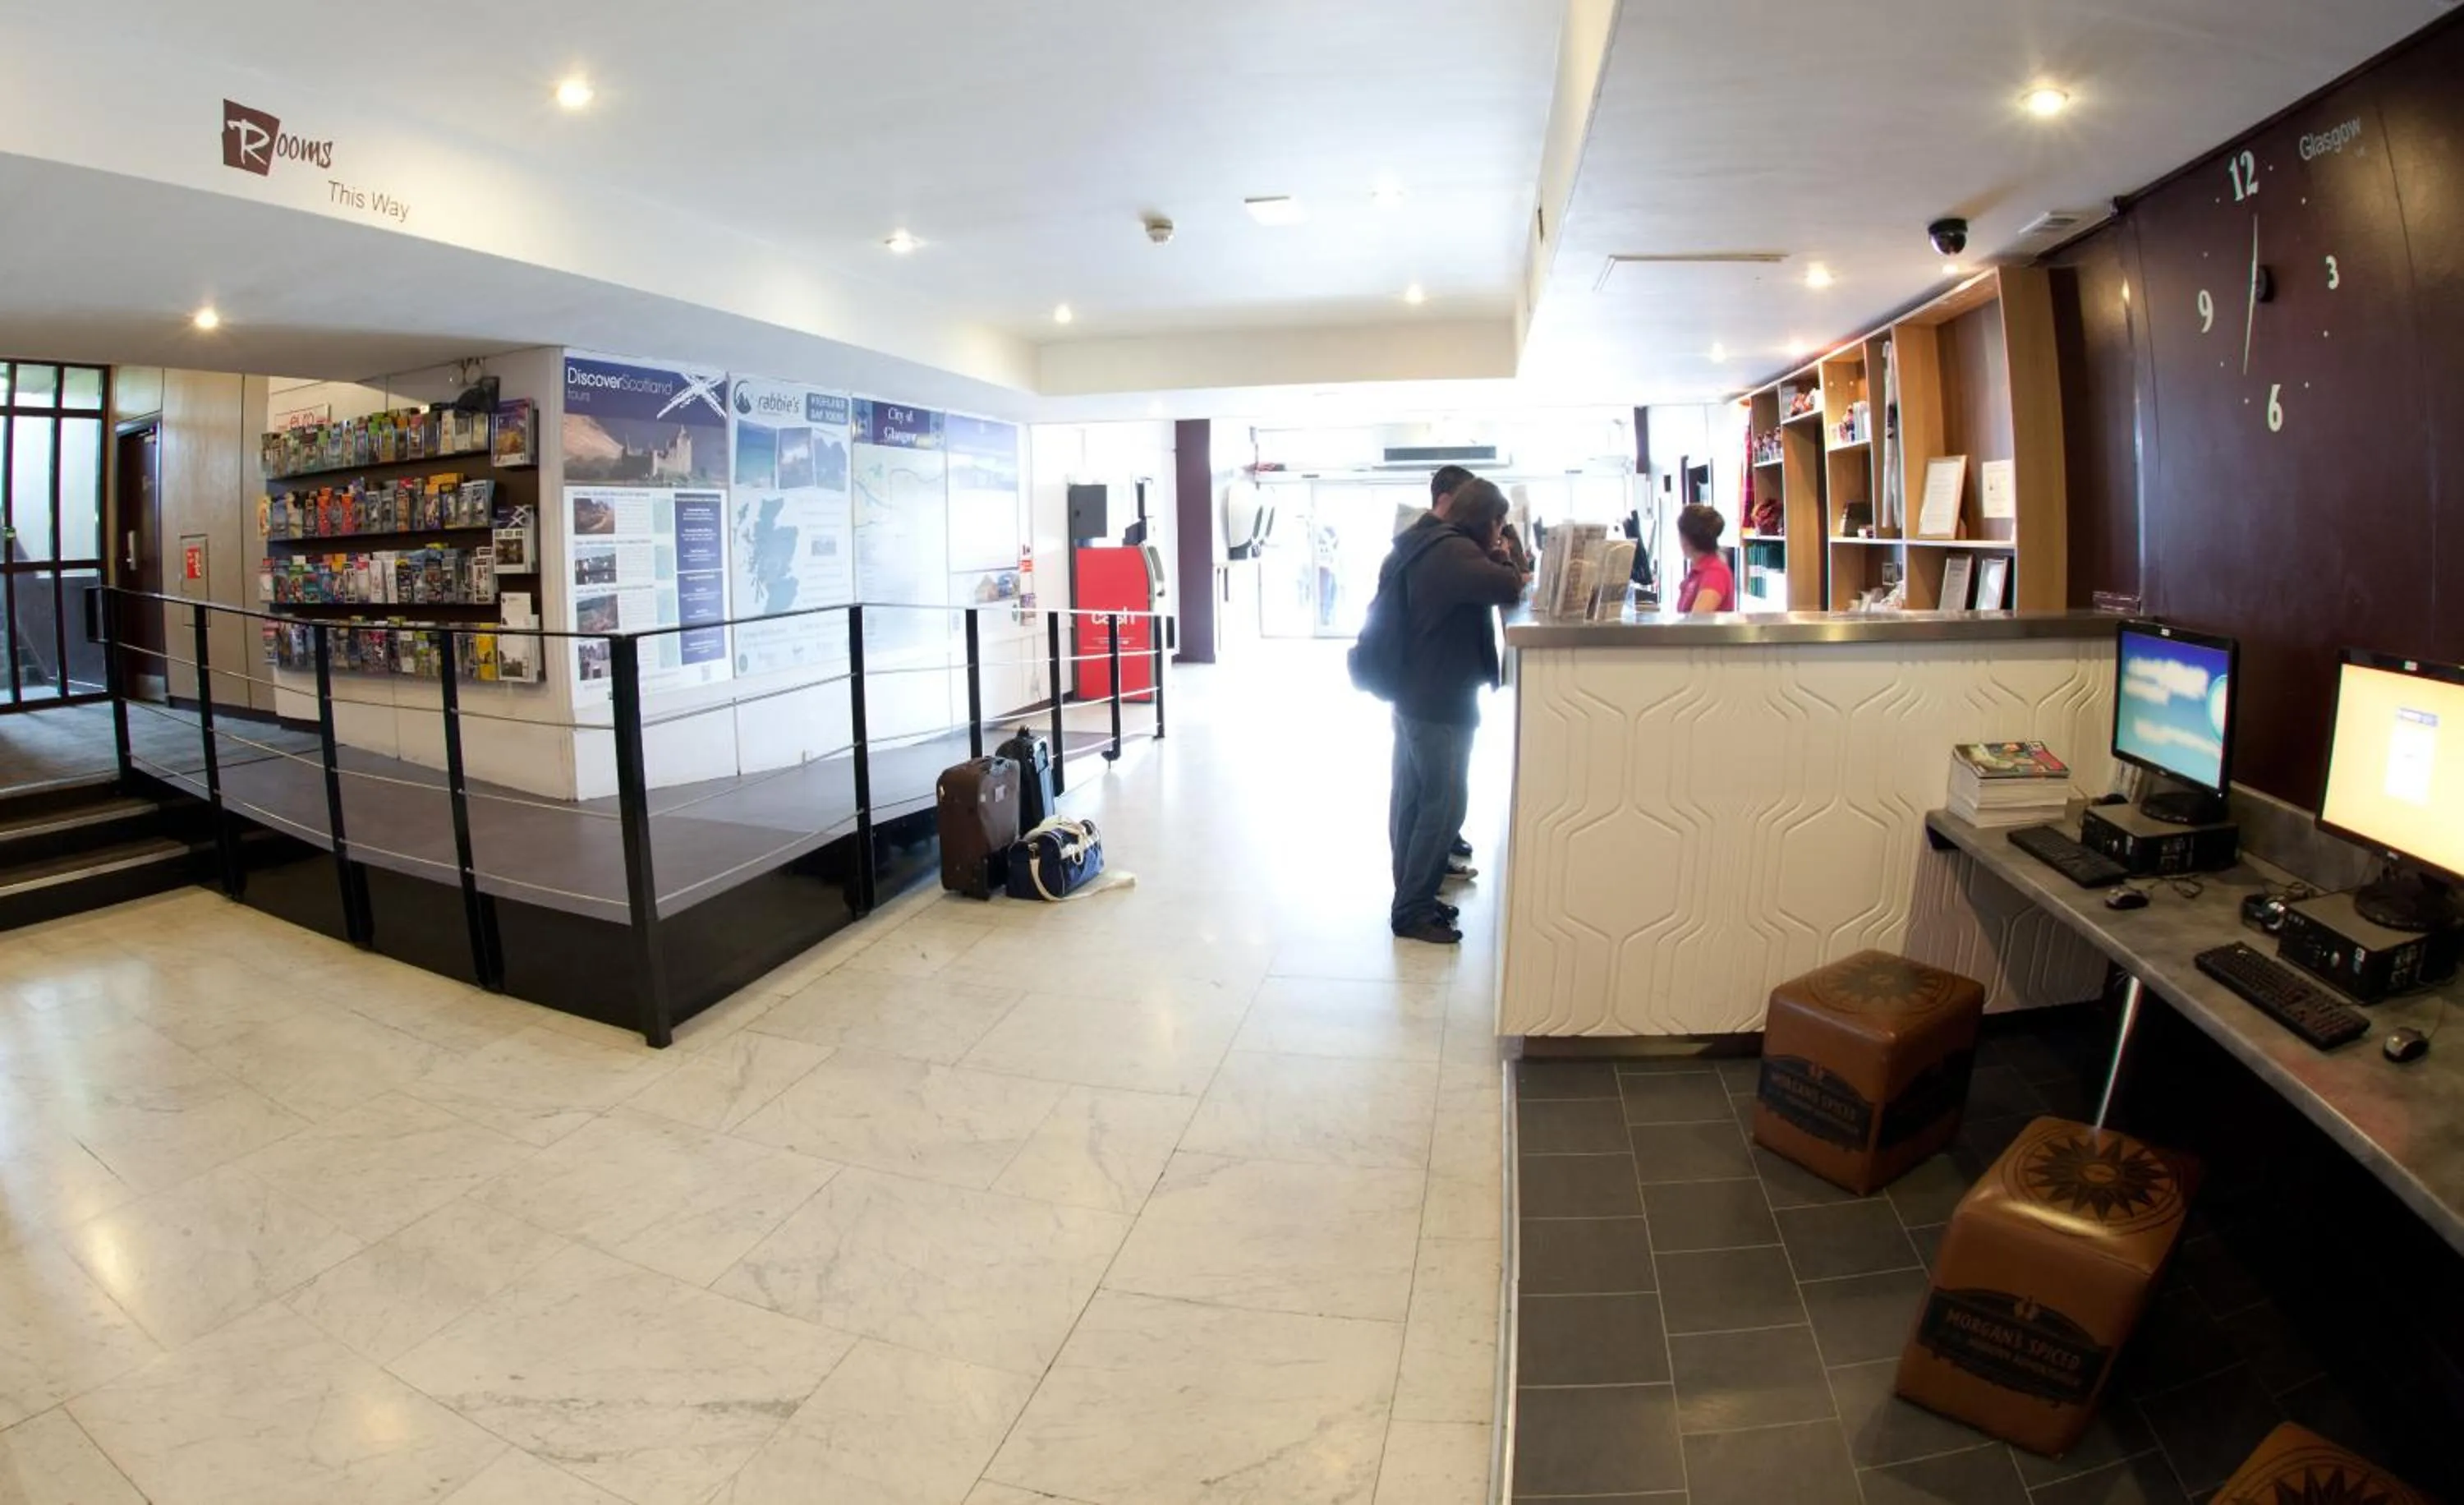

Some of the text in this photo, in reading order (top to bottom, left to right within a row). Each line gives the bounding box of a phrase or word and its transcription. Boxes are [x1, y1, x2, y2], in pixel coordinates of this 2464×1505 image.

[226, 118, 333, 169] Rooms
[2300, 116, 2361, 161] Glasgow
[2228, 150, 2259, 202] 12
[329, 180, 411, 223] This Way
[2325, 255, 2340, 290] 3
[2197, 289, 2213, 334] 9
[2267, 384, 2283, 432] 6
